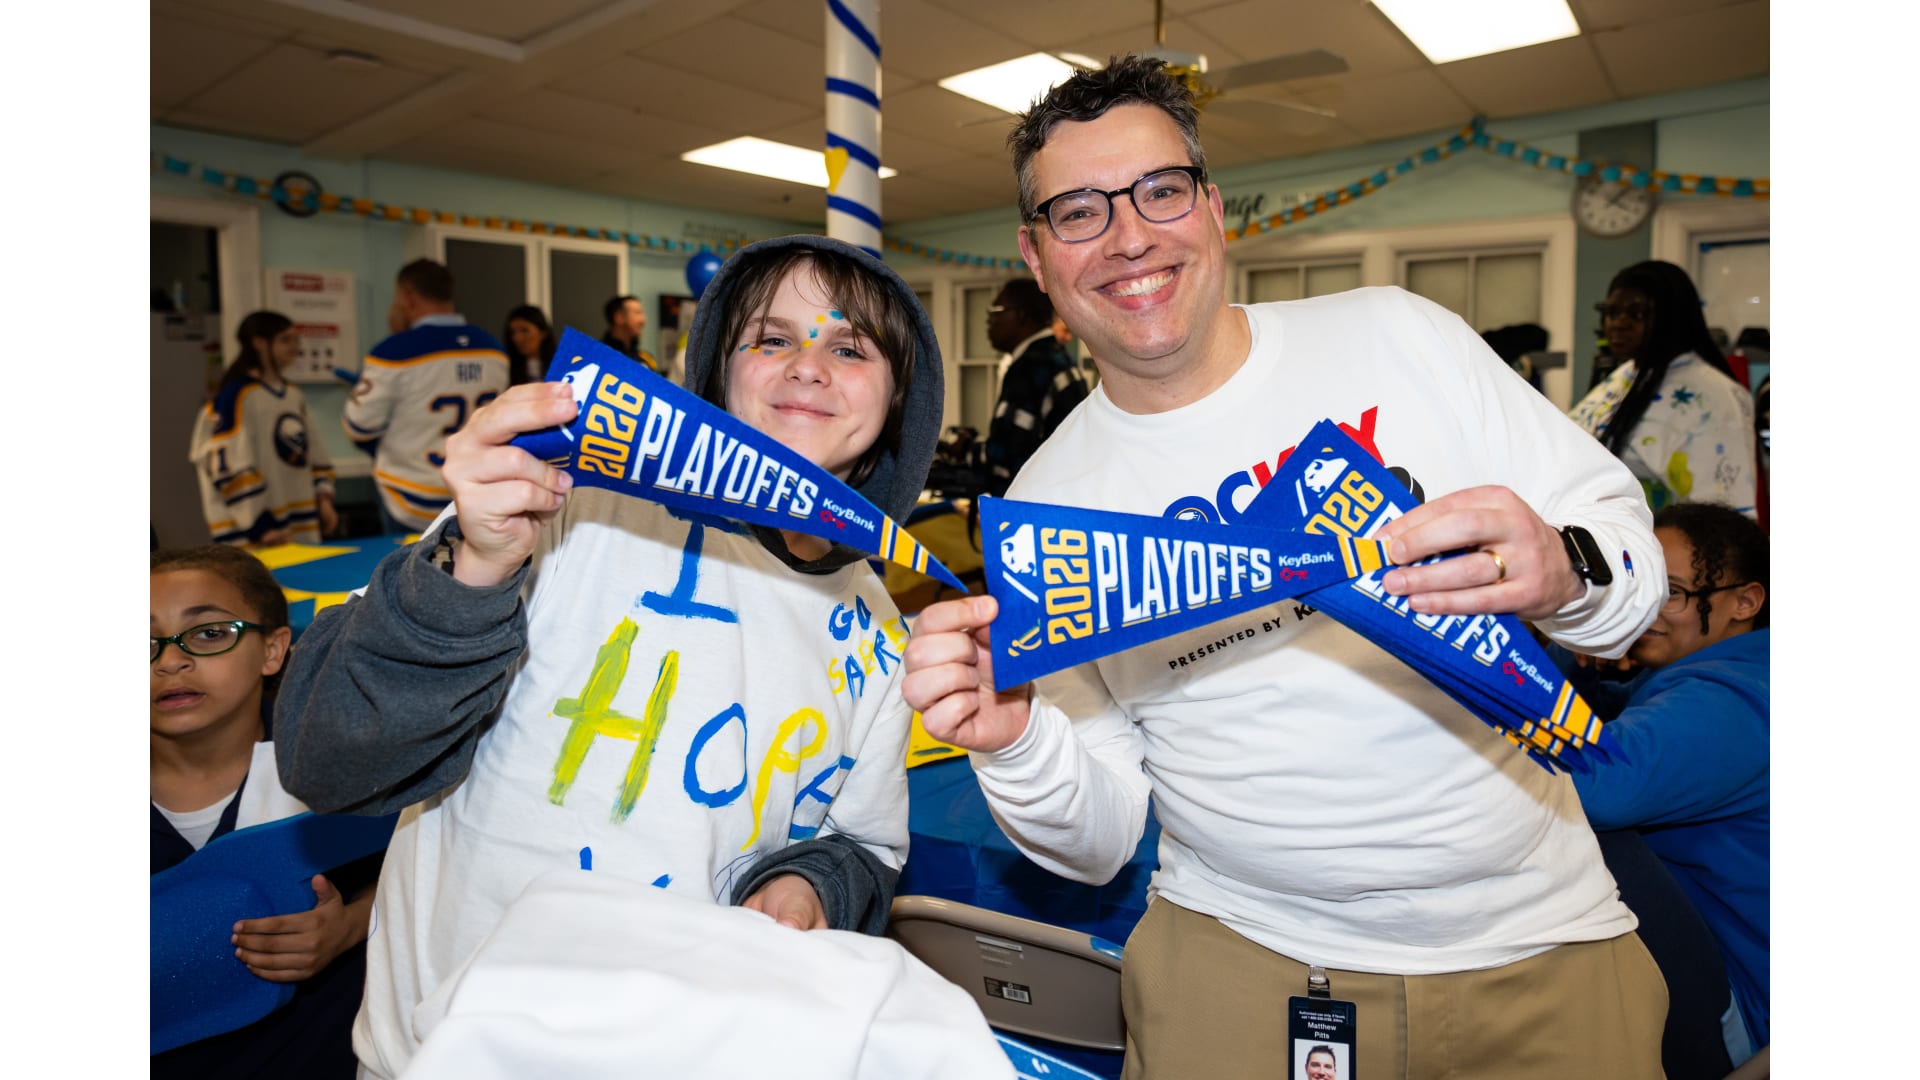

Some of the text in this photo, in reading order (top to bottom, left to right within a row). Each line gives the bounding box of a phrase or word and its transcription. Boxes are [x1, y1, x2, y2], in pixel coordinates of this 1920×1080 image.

[577, 373, 646, 480] 2026
[628, 396, 819, 519] PLAYOFFS
[821, 497, 876, 533] KeyBank
[636, 503, 755, 624] I
[1040, 527, 1093, 645] 2026
[1092, 530, 1273, 634] PLAYOFFS
[1278, 551, 1335, 568] KeyBank
[829, 594, 872, 641] GO
[1168, 617, 1282, 670] PRESENTED BY
[1508, 649, 1554, 694] KeyBank
[547, 616, 858, 852] HOPE
[1307, 1021, 1337, 1031] Matthew
[1314, 1031, 1330, 1039] Pitts
